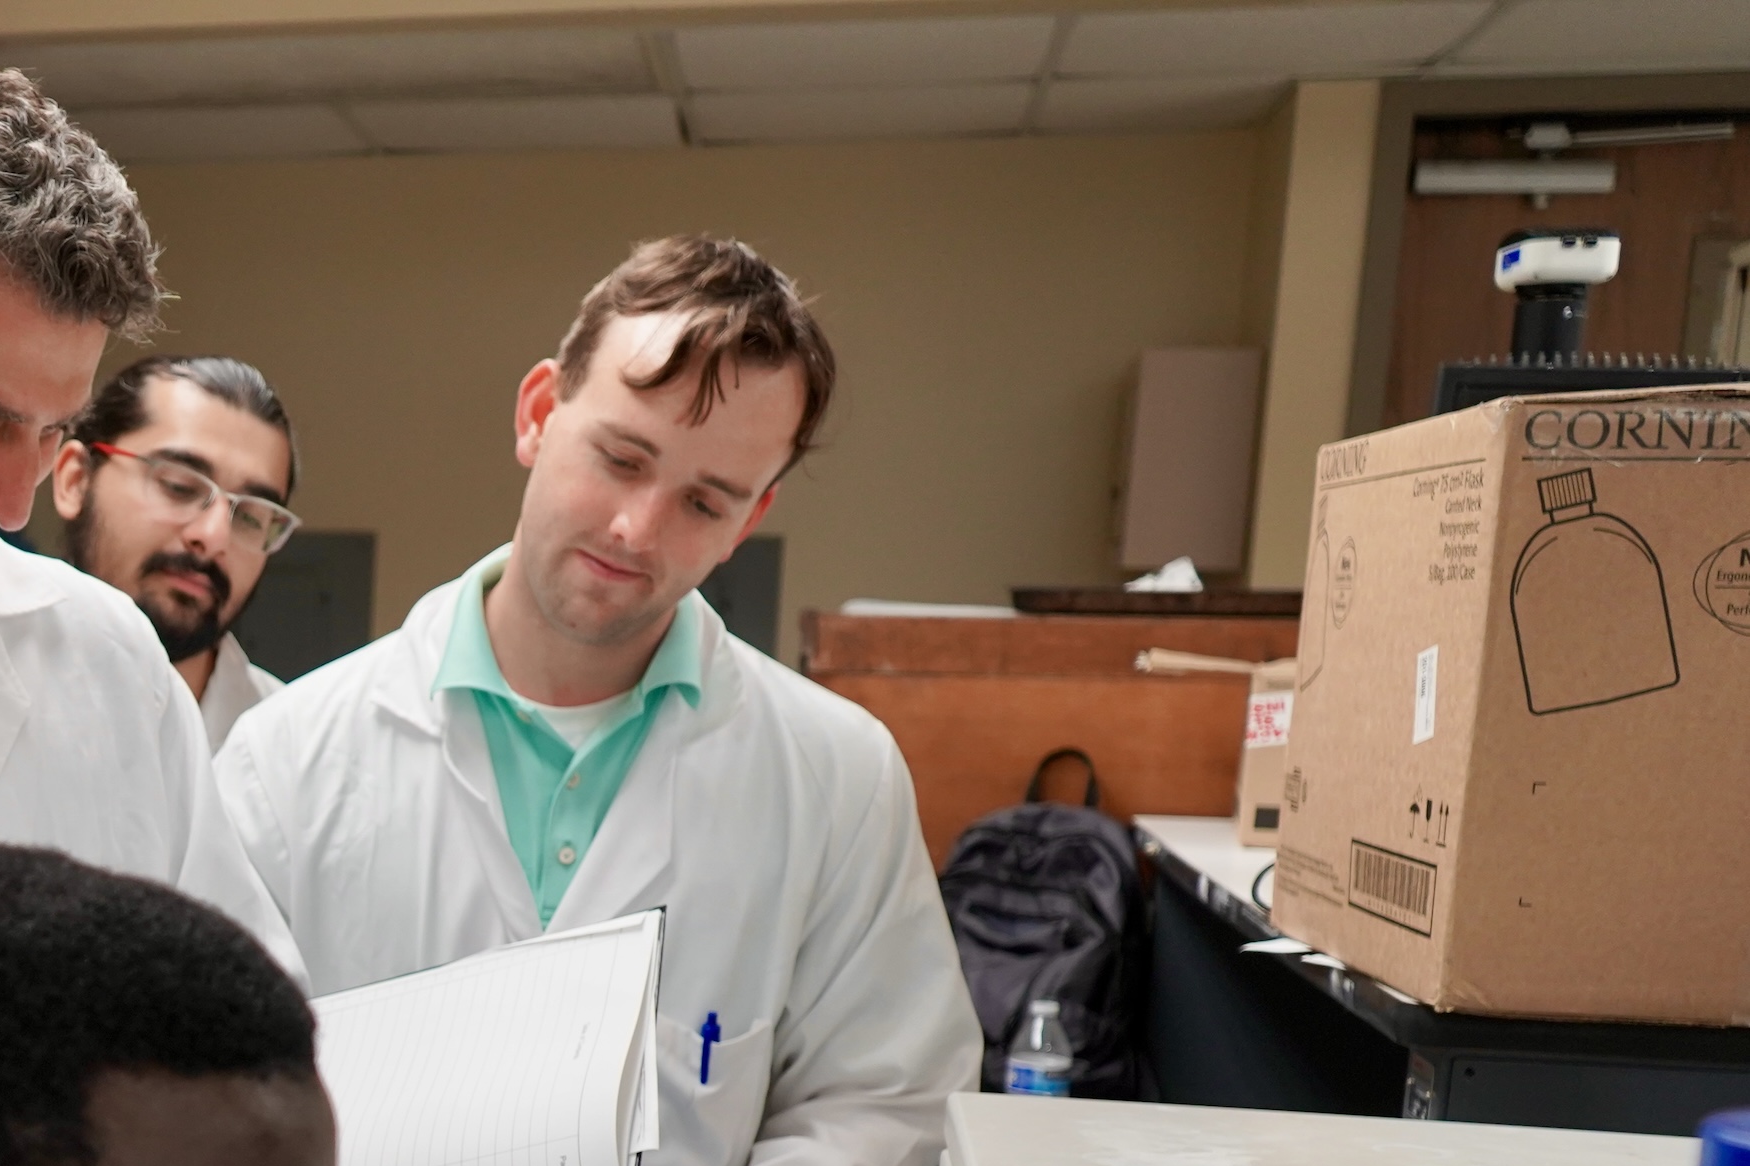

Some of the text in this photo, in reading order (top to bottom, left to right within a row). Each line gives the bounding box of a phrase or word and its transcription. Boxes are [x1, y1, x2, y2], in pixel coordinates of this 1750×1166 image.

[1464, 466, 1484, 489] Flask
[1466, 495, 1482, 512] Neck
[1716, 570, 1750, 585] Ergon
[1726, 603, 1750, 617] Perf
